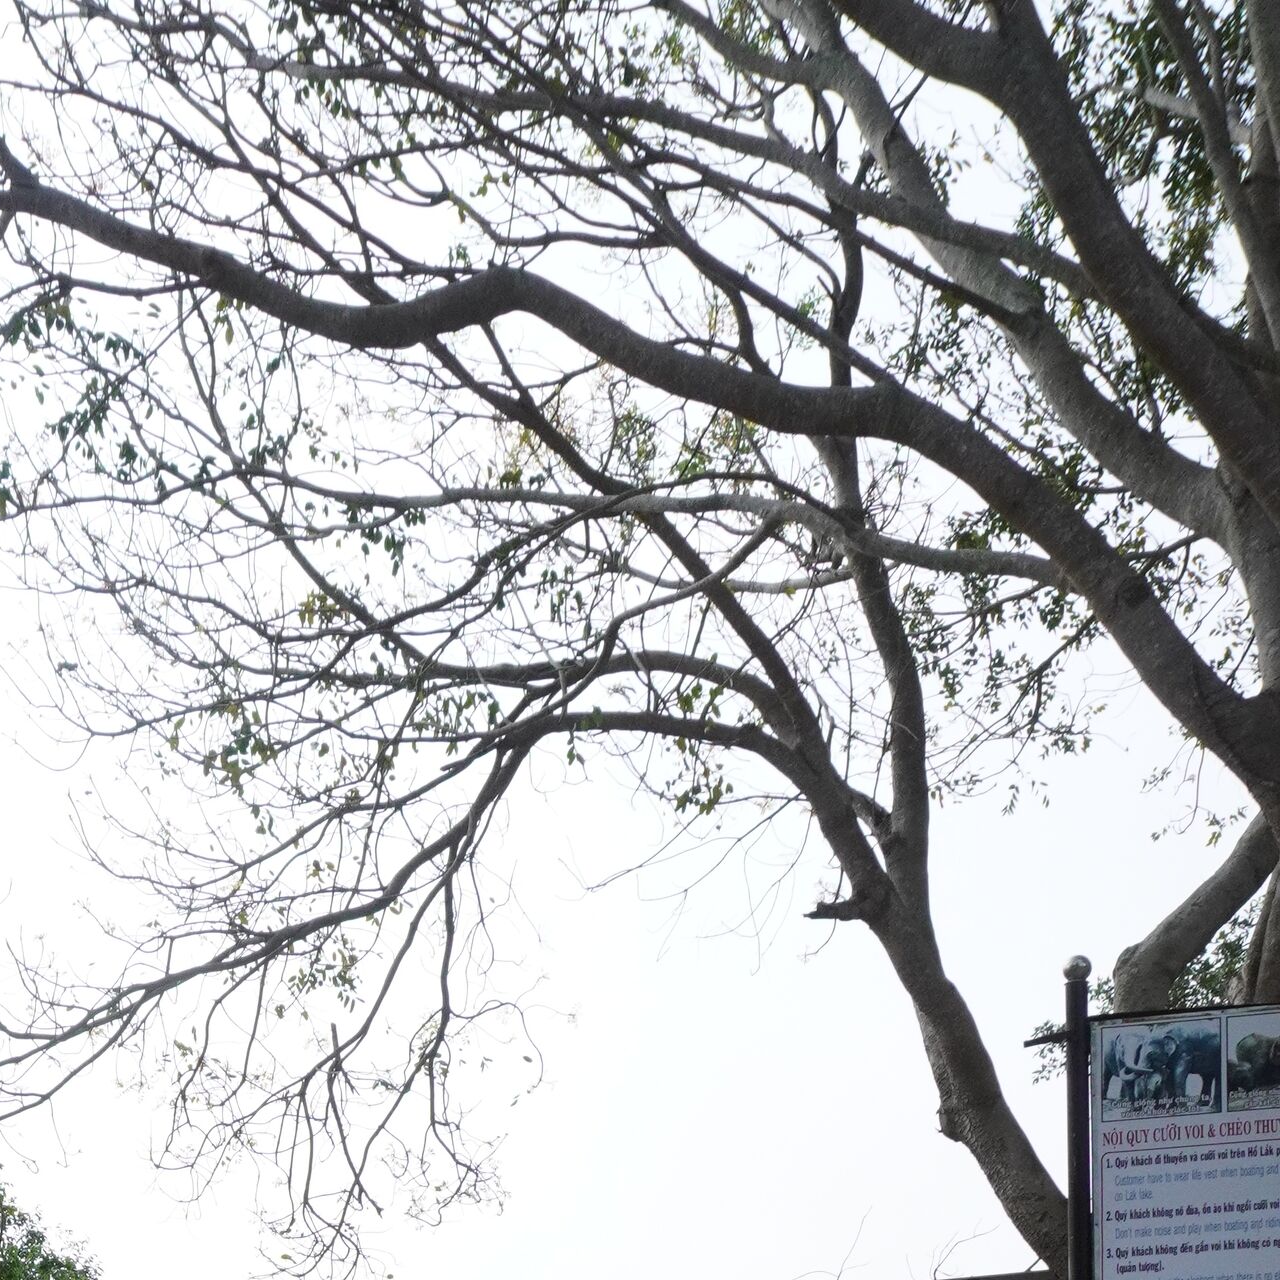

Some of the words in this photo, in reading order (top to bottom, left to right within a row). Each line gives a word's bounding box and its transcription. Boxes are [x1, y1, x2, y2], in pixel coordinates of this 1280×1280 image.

[1103, 1128, 1123, 1149] NỘI
[1126, 1129, 1150, 1147] QUY
[1153, 1122, 1181, 1142] CƯỠI
[1185, 1124, 1204, 1139] VOI
[1208, 1123, 1216, 1138] &
[1219, 1117, 1251, 1137] CHÈO
[1106, 1158, 1113, 1168] 1.
[1115, 1156, 1128, 1169] Quý
[1131, 1154, 1153, 1166] khách
[1217, 1149, 1228, 1160] voi
[1230, 1147, 1246, 1158] trên
[1106, 1211, 1113, 1221] 2.
[1114, 1209, 1127, 1222] Quý
[1129, 1207, 1151, 1219] khách
[1152, 1206, 1174, 1219] không
[1223, 1201, 1234, 1213] khi
[1106, 1248, 1114, 1259] 3.
[1115, 1246, 1129, 1259] Quý
[1131, 1245, 1153, 1257] khách
[1155, 1244, 1178, 1256] không
[1211, 1240, 1221, 1251] voi
[1223, 1239, 1235, 1250] khi
[1237, 1238, 1260, 1250] không
